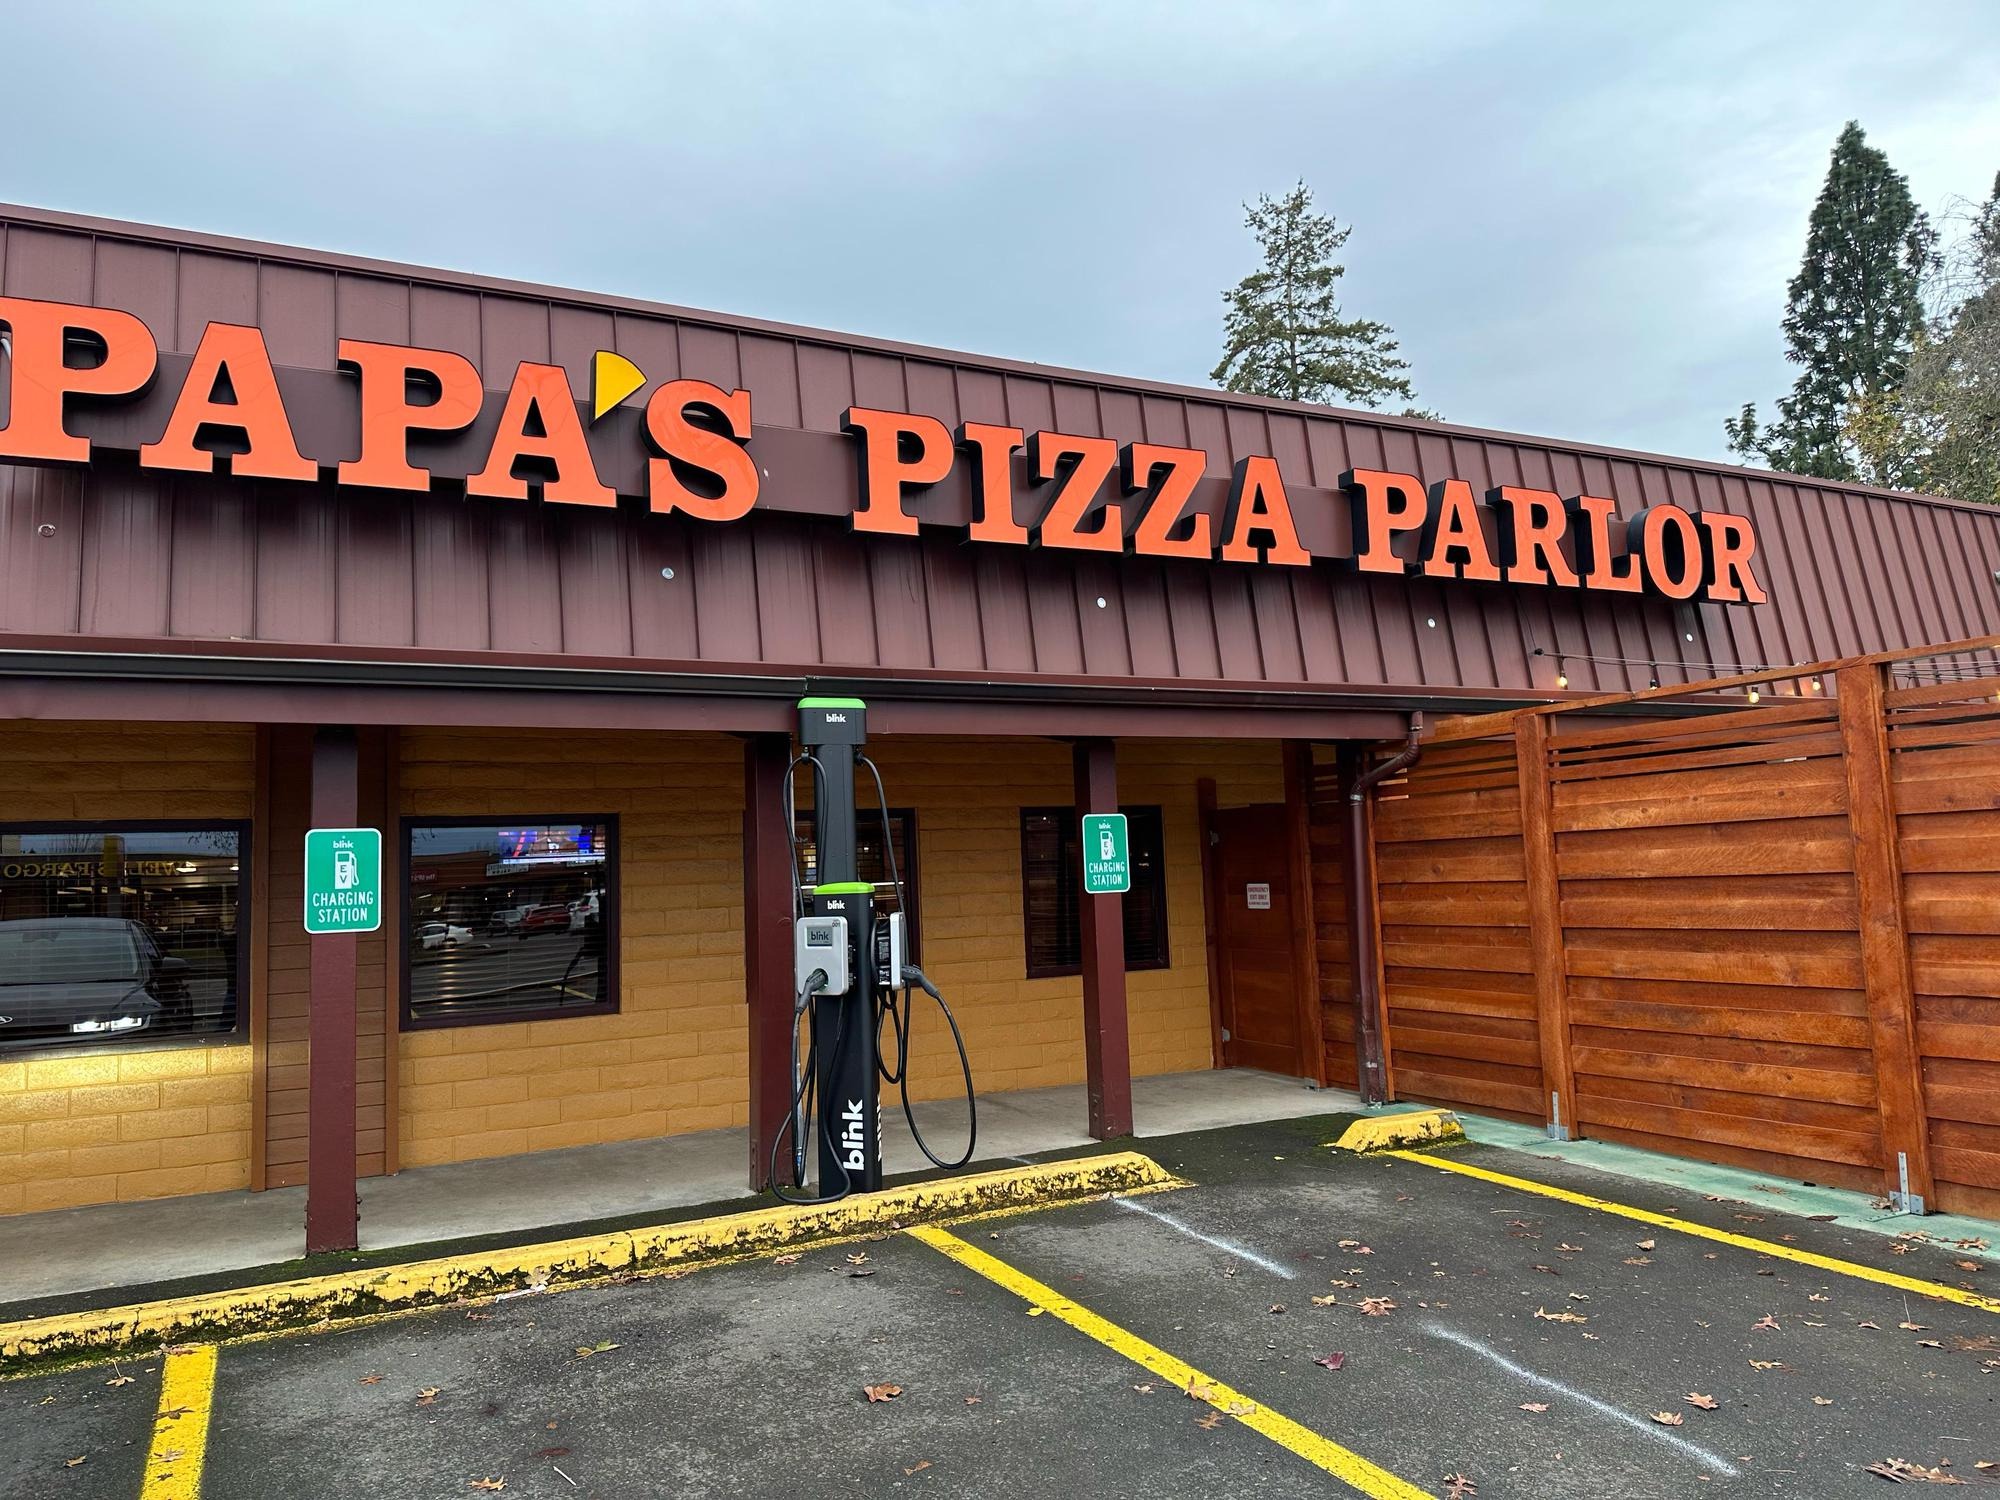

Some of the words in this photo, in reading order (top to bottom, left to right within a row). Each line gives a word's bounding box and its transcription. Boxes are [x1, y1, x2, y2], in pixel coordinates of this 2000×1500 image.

[0, 296, 760, 521] PAPA'S
[843, 406, 1311, 566] PIZZA
[1342, 468, 1767, 604] PARLOR
[826, 713, 847, 723] blink
[333, 840, 354, 849] blink
[1088, 861, 1126, 874] CHARGING
[1093, 874, 1122, 886] STATION
[312, 891, 374, 907] CHARGING
[827, 899, 845, 910] blink
[318, 908, 368, 924] STATION
[810, 931, 829, 940] blink
[841, 1099, 865, 1170] blink
